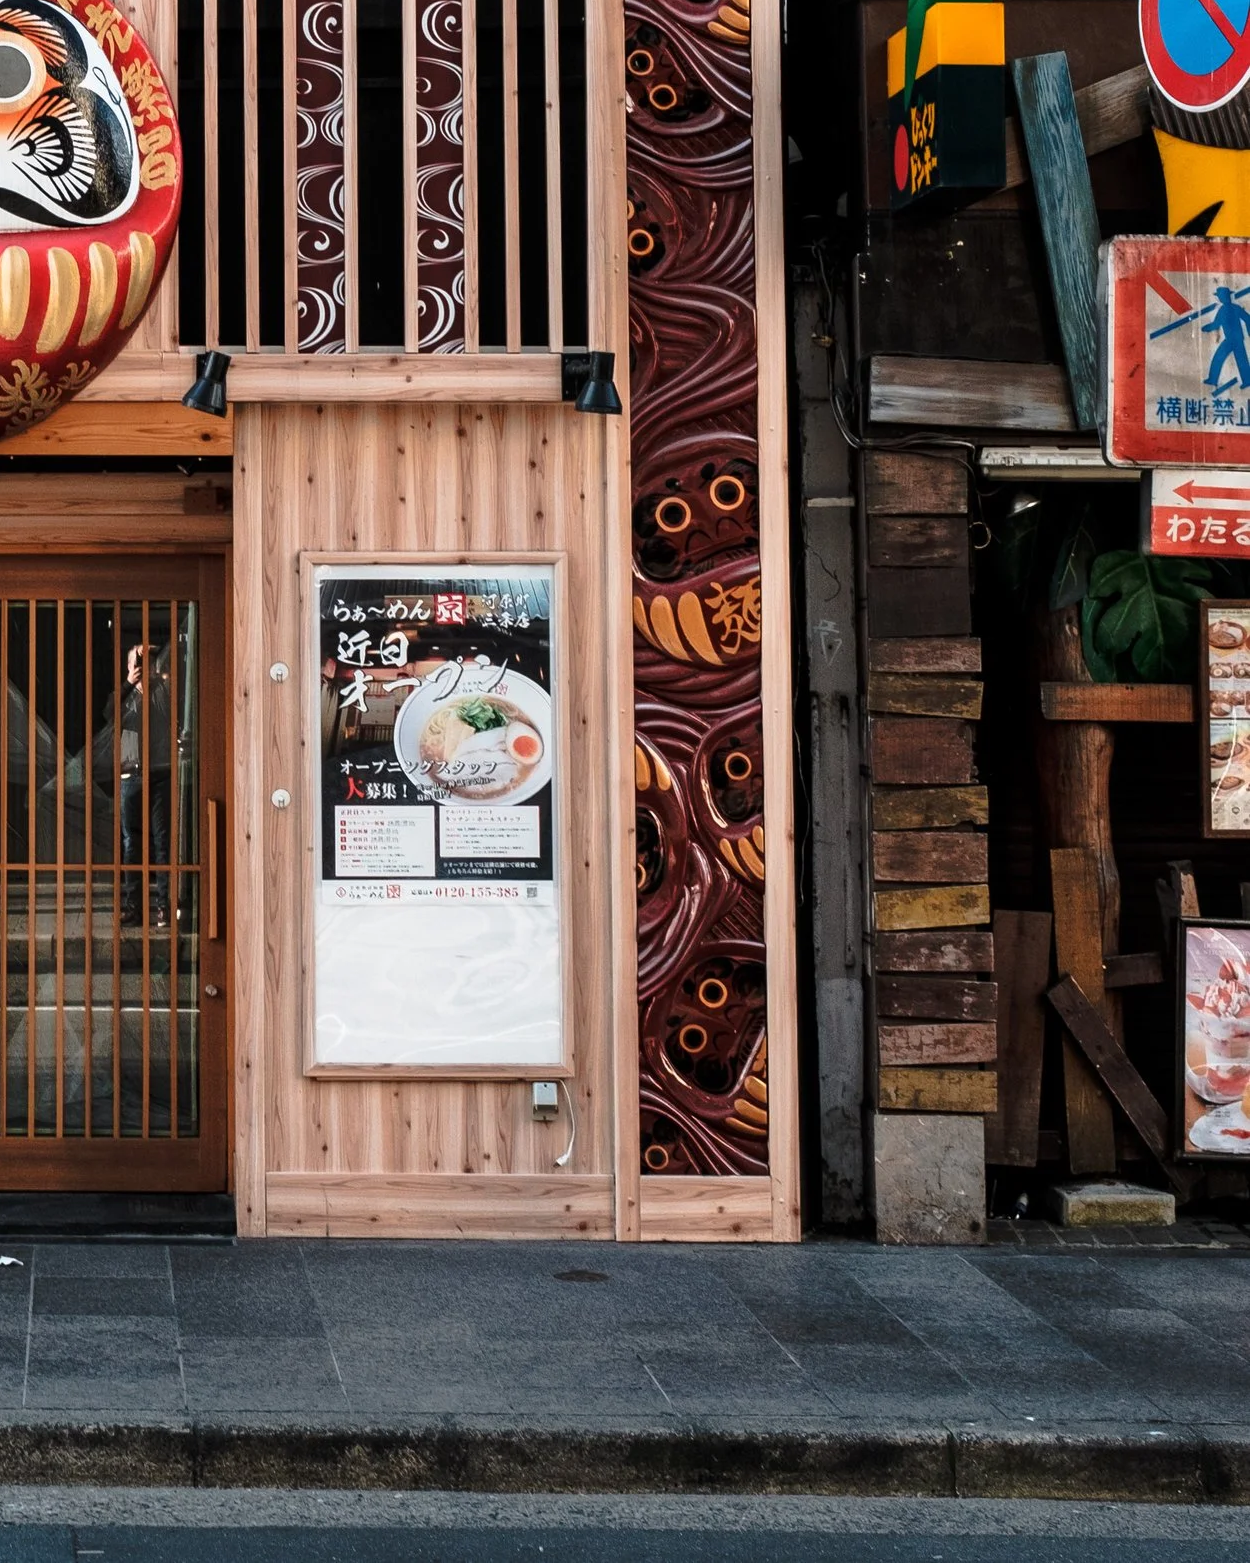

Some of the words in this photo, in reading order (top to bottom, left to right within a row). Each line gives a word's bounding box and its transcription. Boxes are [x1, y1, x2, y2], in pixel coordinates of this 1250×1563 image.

[910, 101, 936, 149] びっくり
[910, 144, 938, 196] ドンキー
[336, 629, 410, 668] 近日
[338, 653, 508, 713] オープン
[340, 759, 498, 775] オープニングスタッフ
